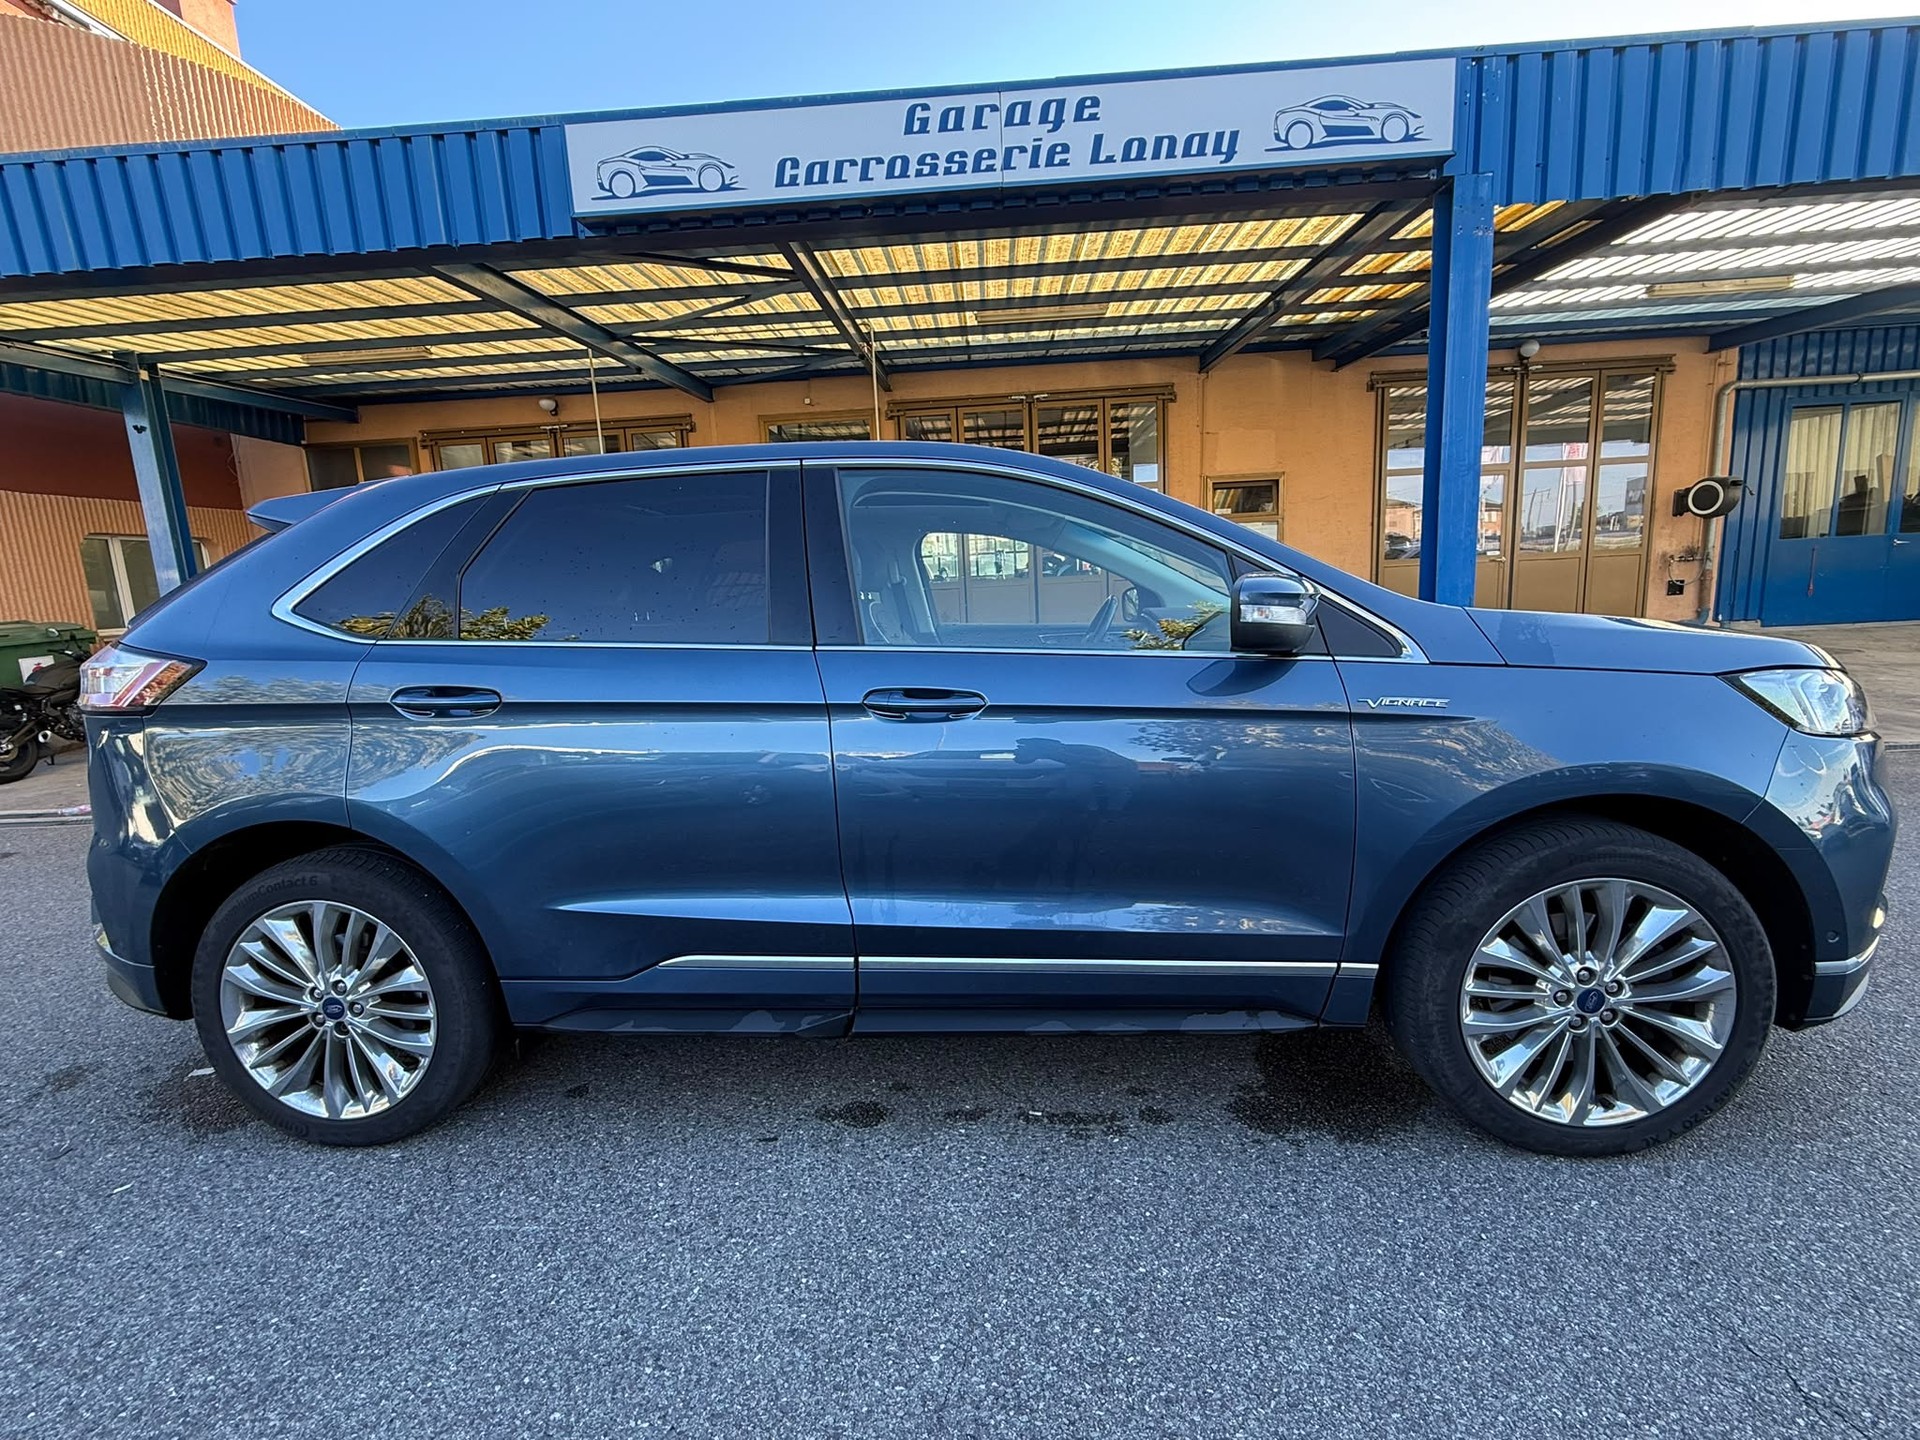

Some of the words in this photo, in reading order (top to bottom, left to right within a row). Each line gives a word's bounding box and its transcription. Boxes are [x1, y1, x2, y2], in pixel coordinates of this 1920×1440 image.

[903, 95, 1101, 136] Garage
[775, 138, 1071, 188] Carrosserie
[1089, 129, 1240, 164] Lonay
